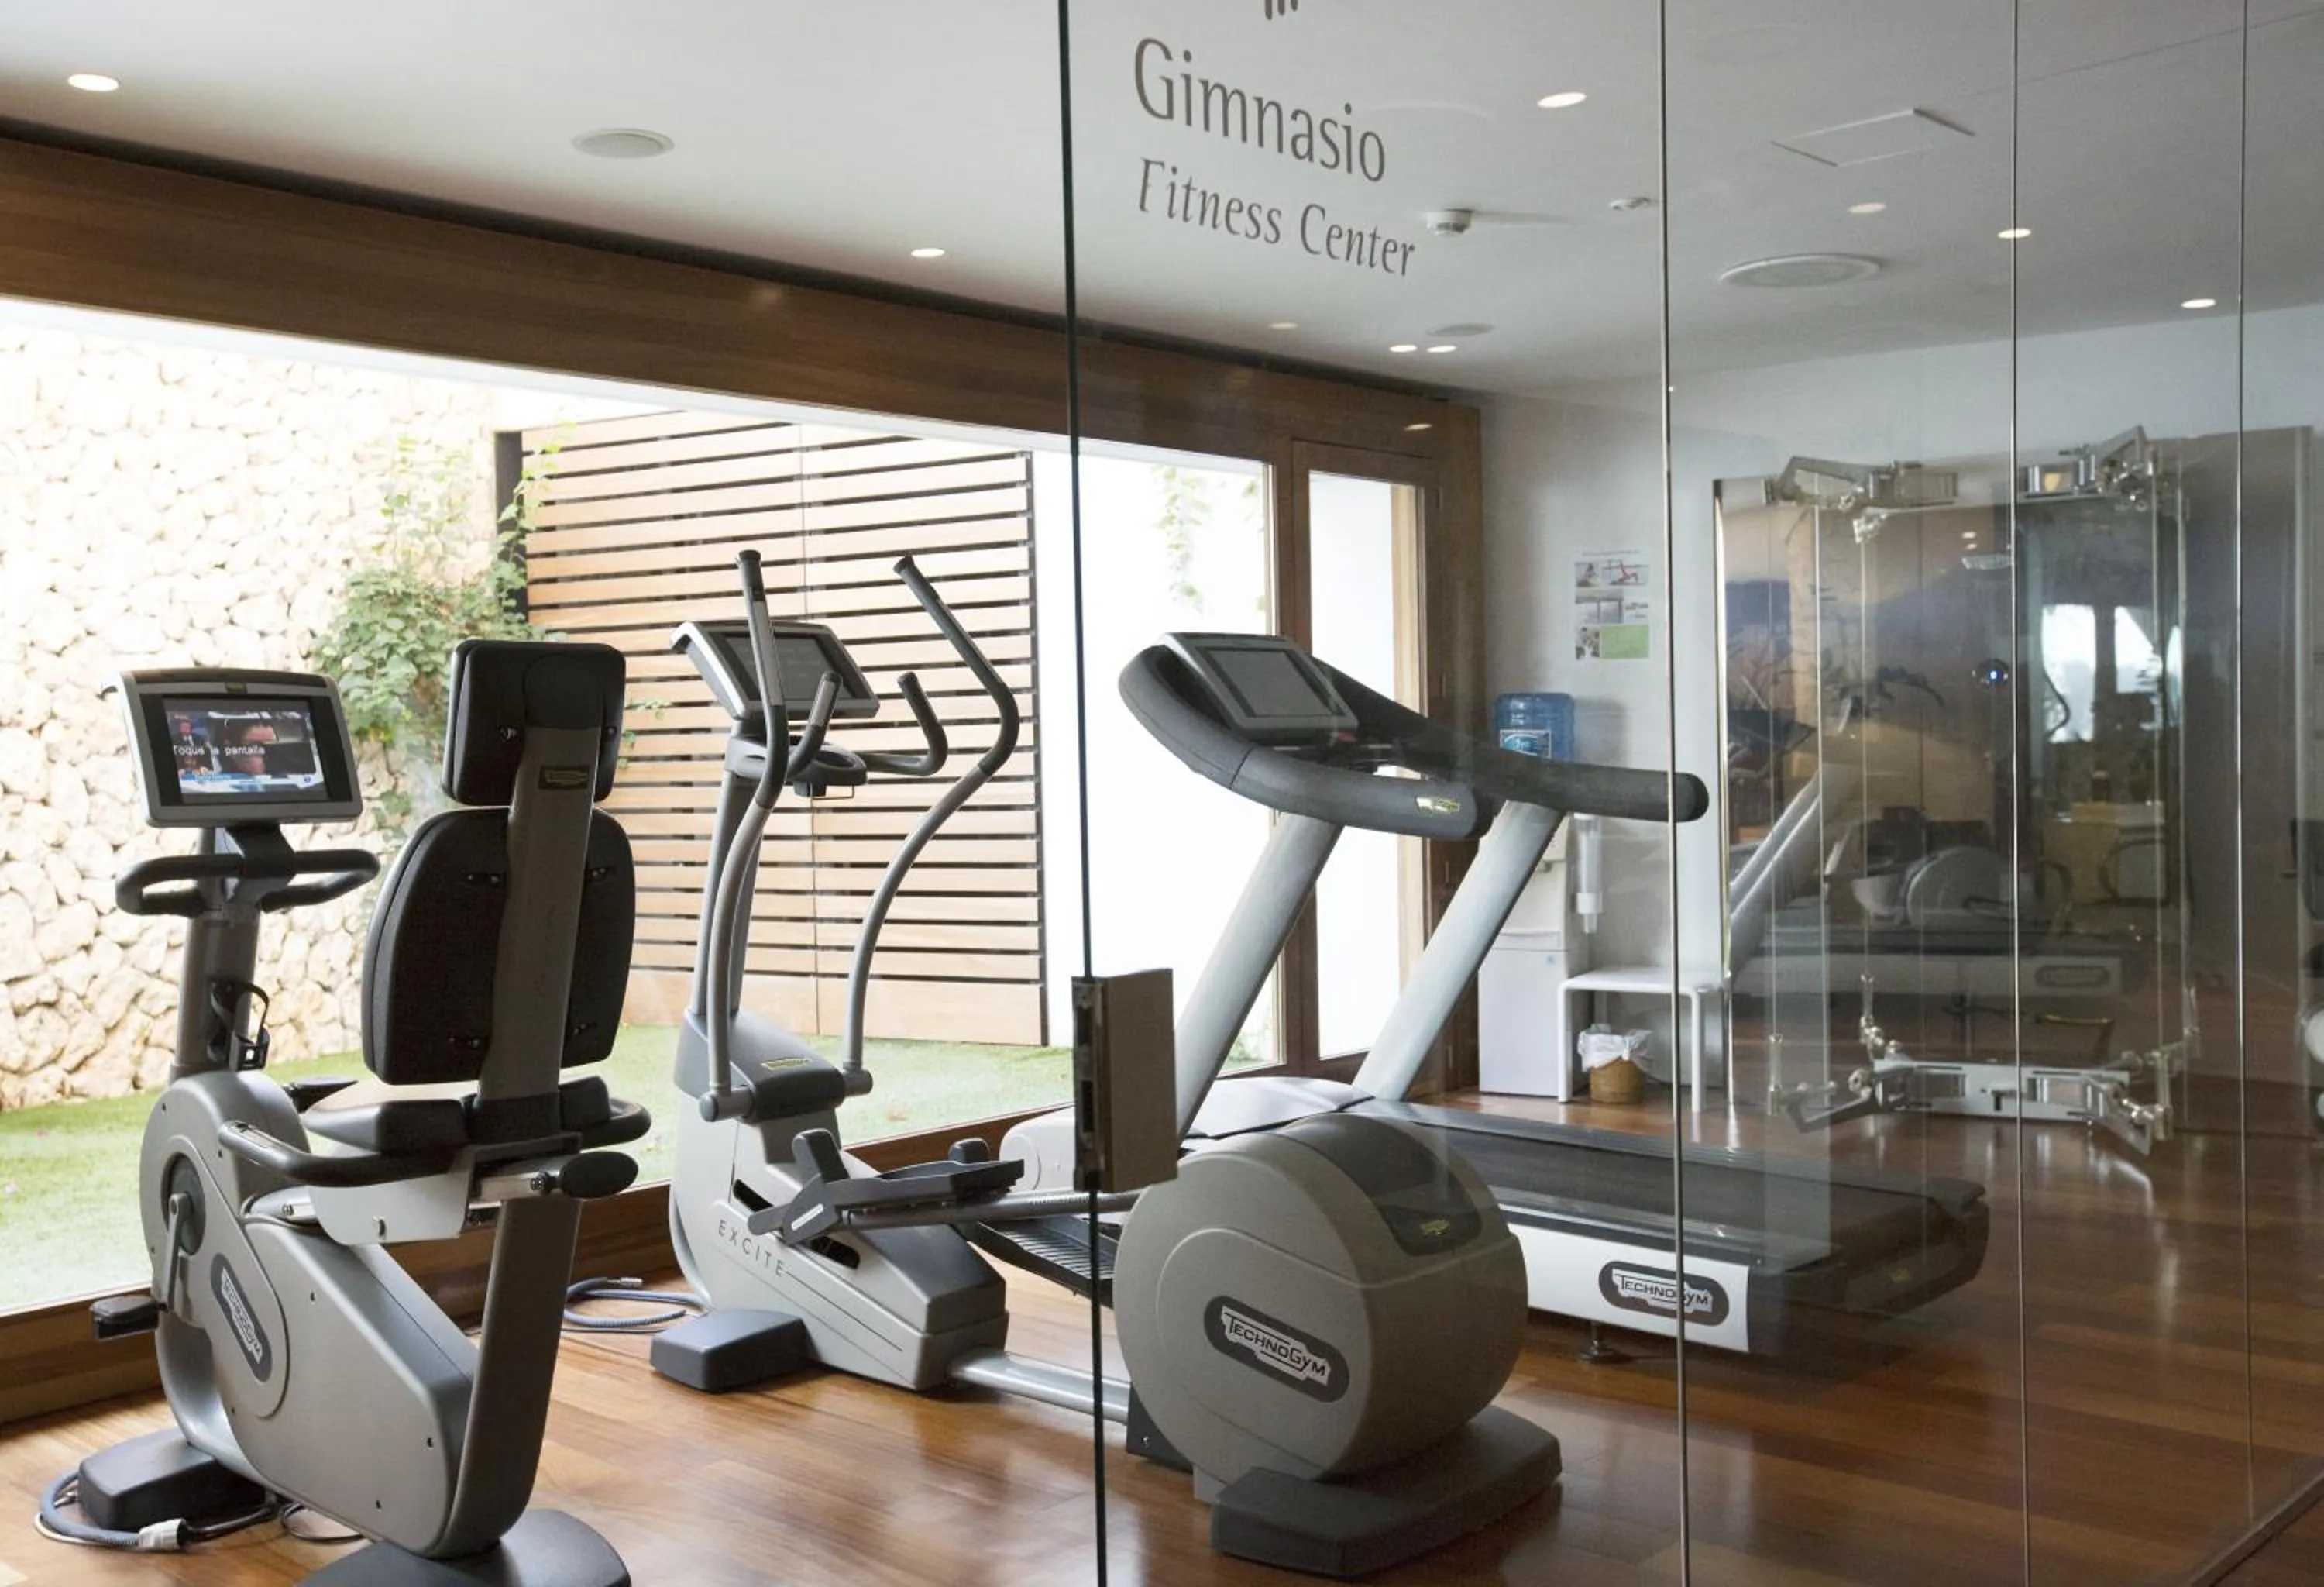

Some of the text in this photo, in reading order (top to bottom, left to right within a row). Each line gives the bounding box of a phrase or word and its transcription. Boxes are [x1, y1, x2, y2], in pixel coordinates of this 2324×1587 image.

[1134, 37, 1386, 182] Gimnasio
[1138, 157, 1415, 277] Fitness Center
[718, 1219, 784, 1278] EXCITE
[1614, 1272, 1709, 1307] TECHNOYM
